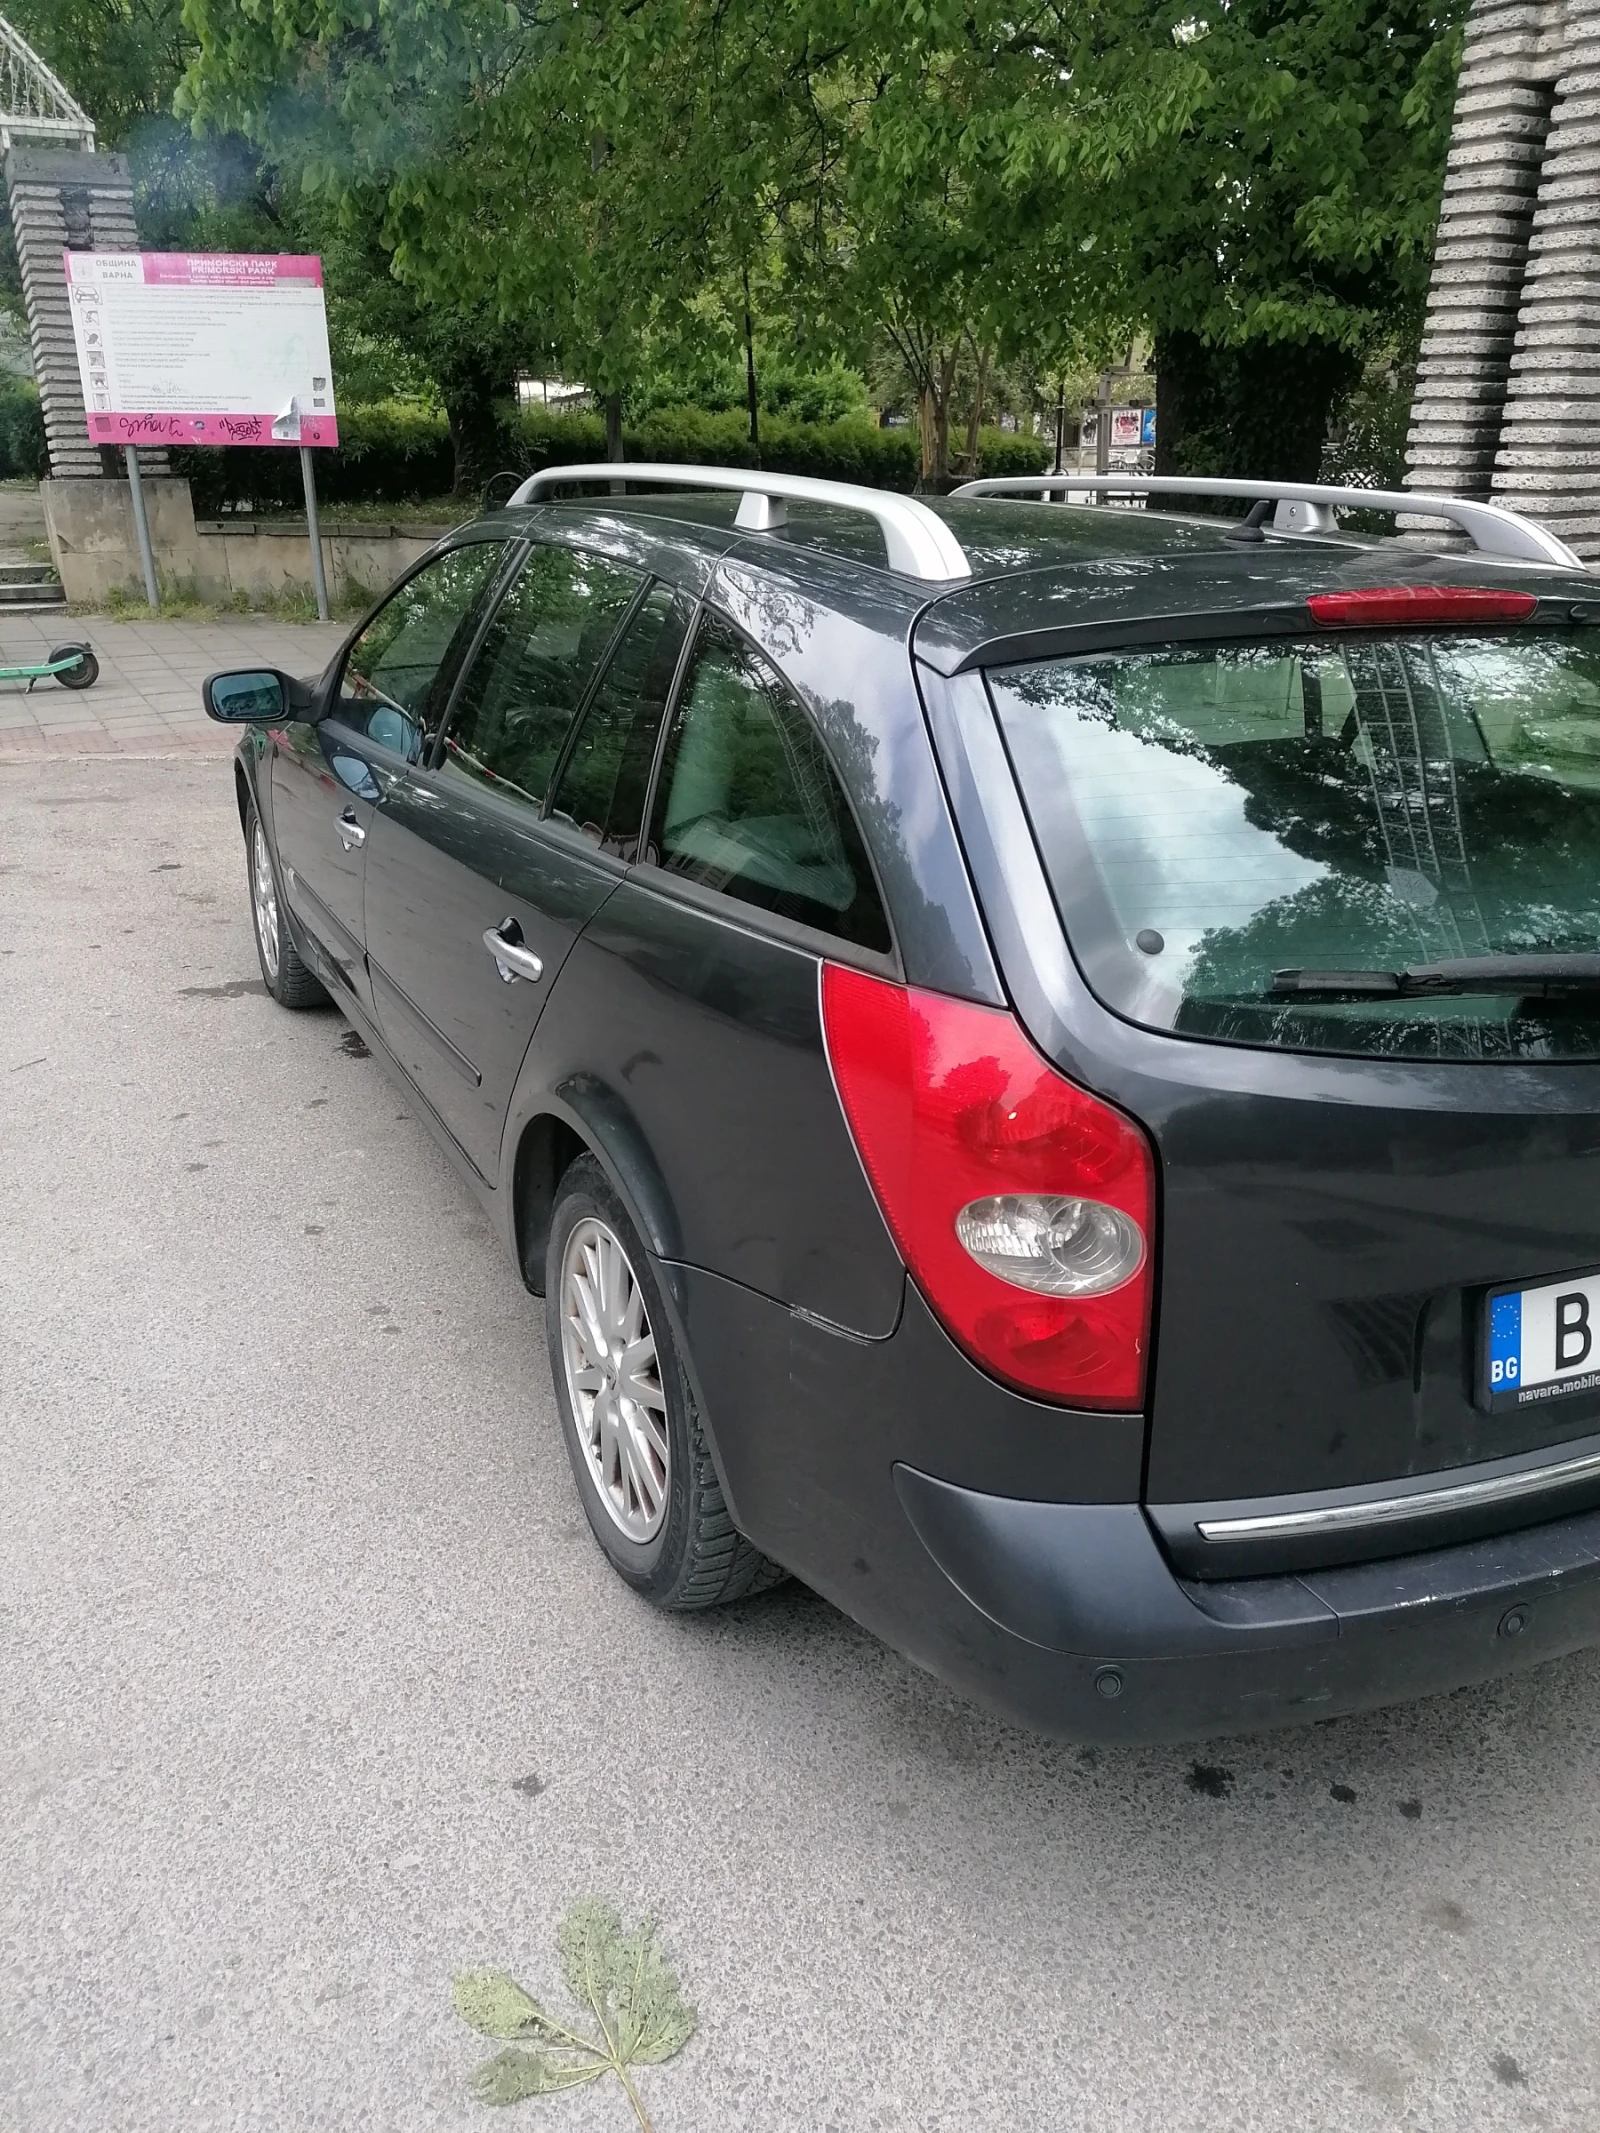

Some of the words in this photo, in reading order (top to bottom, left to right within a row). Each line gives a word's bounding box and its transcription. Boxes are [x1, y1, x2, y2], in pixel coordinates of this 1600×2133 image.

[96, 259, 137, 268] ОБЩИНА
[187, 259, 249, 268] ПРИМОРСКИ
[251, 260, 278, 268] ПАРК
[102, 271, 134, 279] ВАРНА
[191, 266, 246, 274] PRIMORSKI
[248, 267, 275, 275] PARK
[1491, 1356, 1518, 1383] BG
